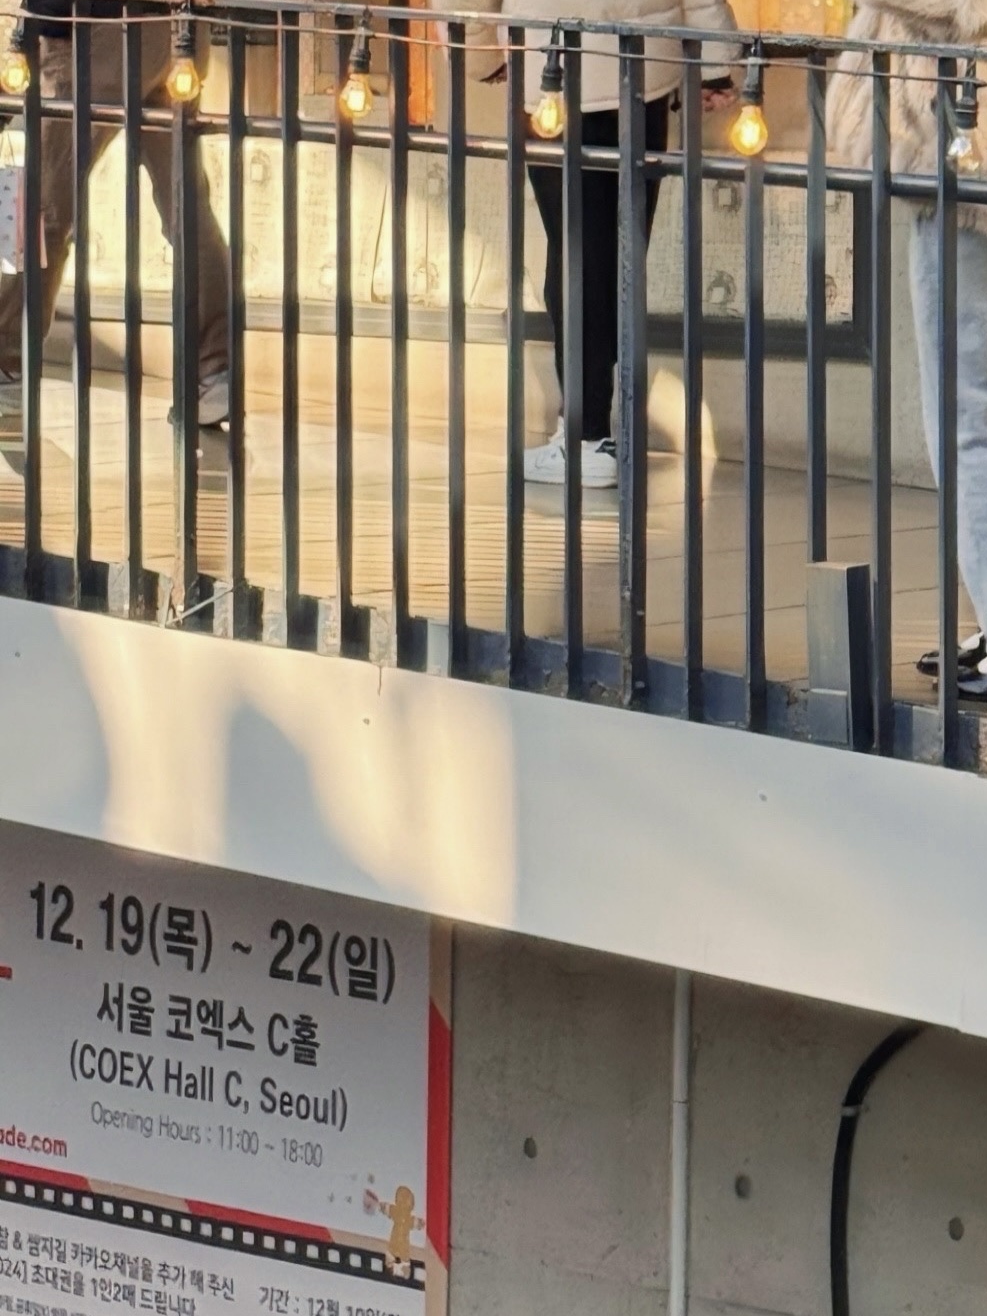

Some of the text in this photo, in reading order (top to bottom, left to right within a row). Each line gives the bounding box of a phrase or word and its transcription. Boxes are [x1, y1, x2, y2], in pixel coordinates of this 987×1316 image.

[30, 881, 83, 950] 12.
[99, 892, 213, 973] 19(목)
[268, 919, 396, 1005] 22(일)
[97, 982, 320, 1067] 서울 코엑스 C홀
[70, 1039, 348, 1132] (COEX Hall C, Seoul)
[91, 1101, 153, 1138] Opening
[159, 1118, 200, 1144] Hours
[218, 1129, 260, 1156] 11:00
[281, 1137, 323, 1167] 18:00
[139, 1287, 197, 1316] 드립니다
[157, 1262, 186, 1290] 추가
[258, 1286, 289, 1314] 기간
